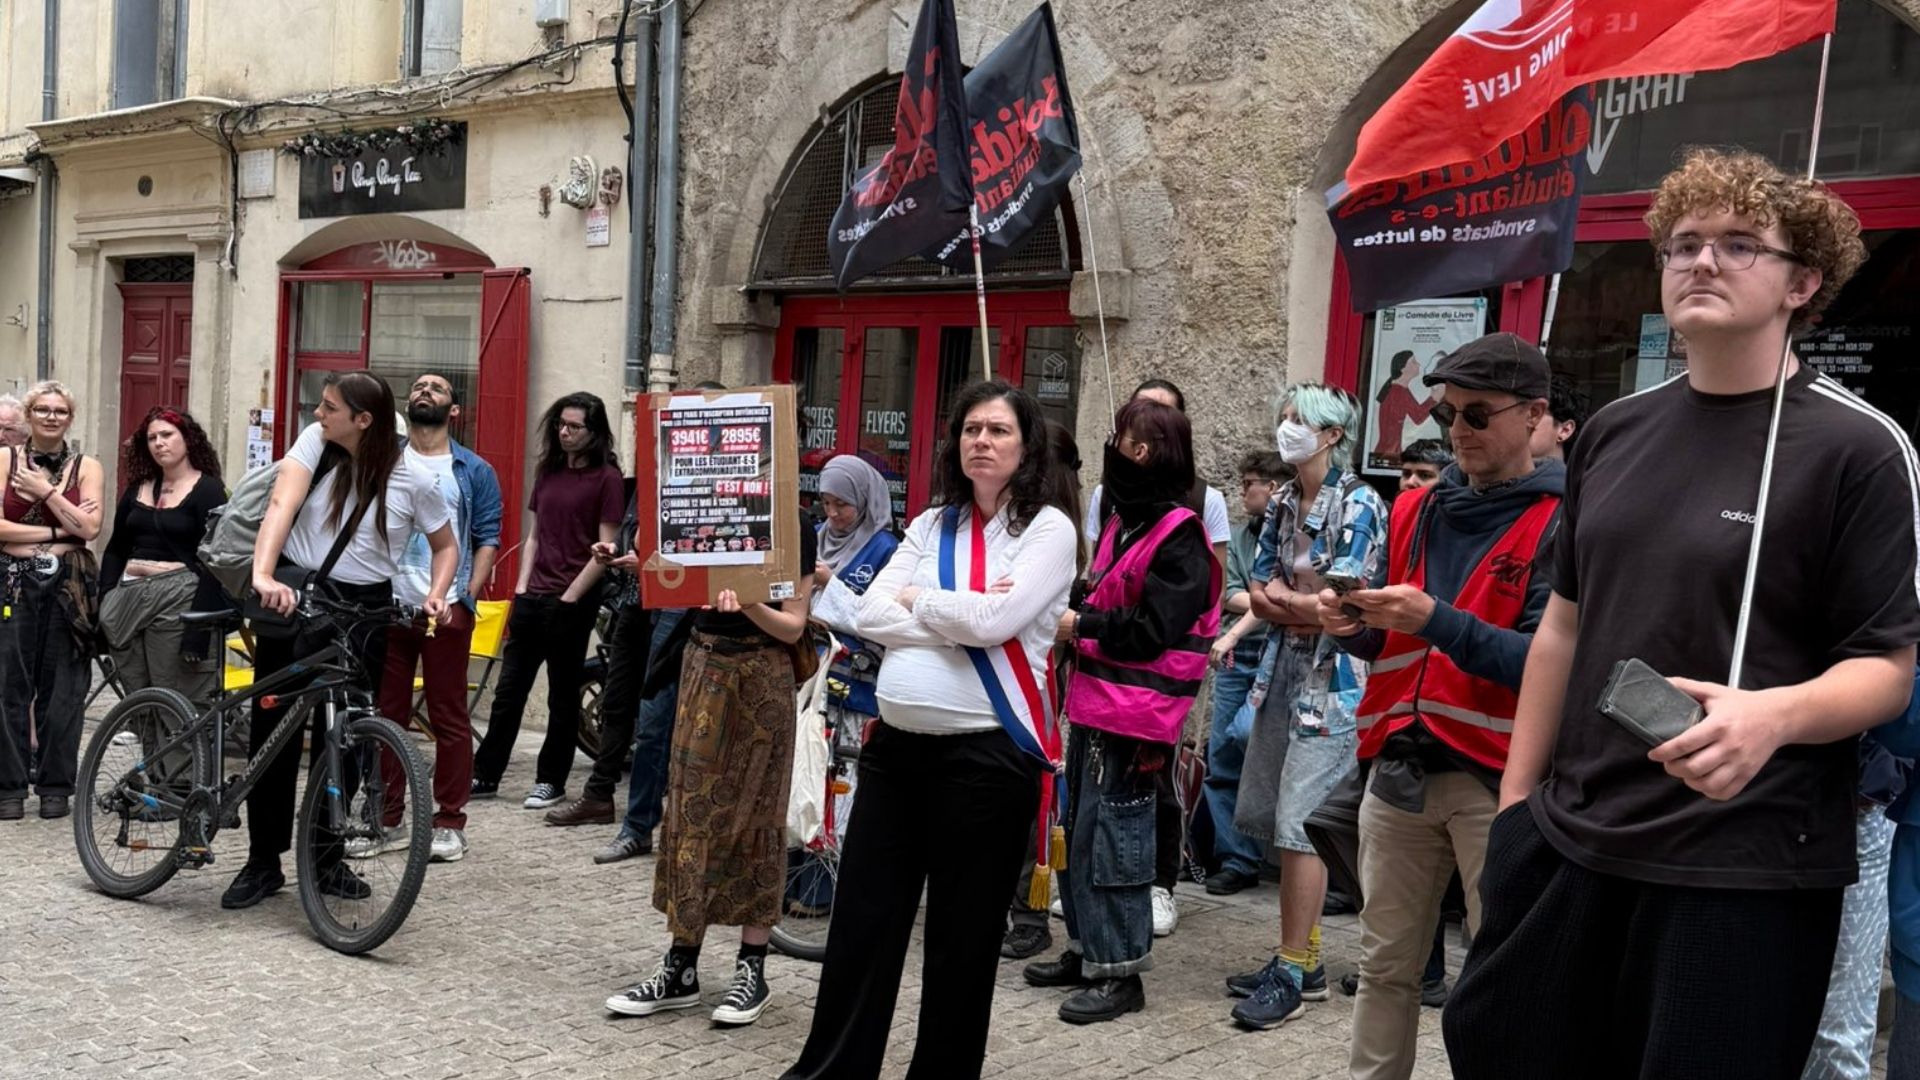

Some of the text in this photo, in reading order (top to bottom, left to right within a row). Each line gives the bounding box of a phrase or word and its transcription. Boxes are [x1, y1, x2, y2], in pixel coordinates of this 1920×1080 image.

[1405, 310, 1440, 320] Comédie
[1454, 310, 1475, 319] Livre
[866, 410, 906, 434] FLYERS
[671, 427, 761, 446] 3941€ 2895€
[806, 429, 838, 450] VISITE
[675, 457, 693, 467] POUR
[695, 456, 707, 466] LES
[675, 465, 756, 477] EXTRACOMMUNAUTAIRES
[716, 480, 740, 494] C'EST
[743, 480, 763, 494] NON
[1721, 510, 1758, 524] adida
